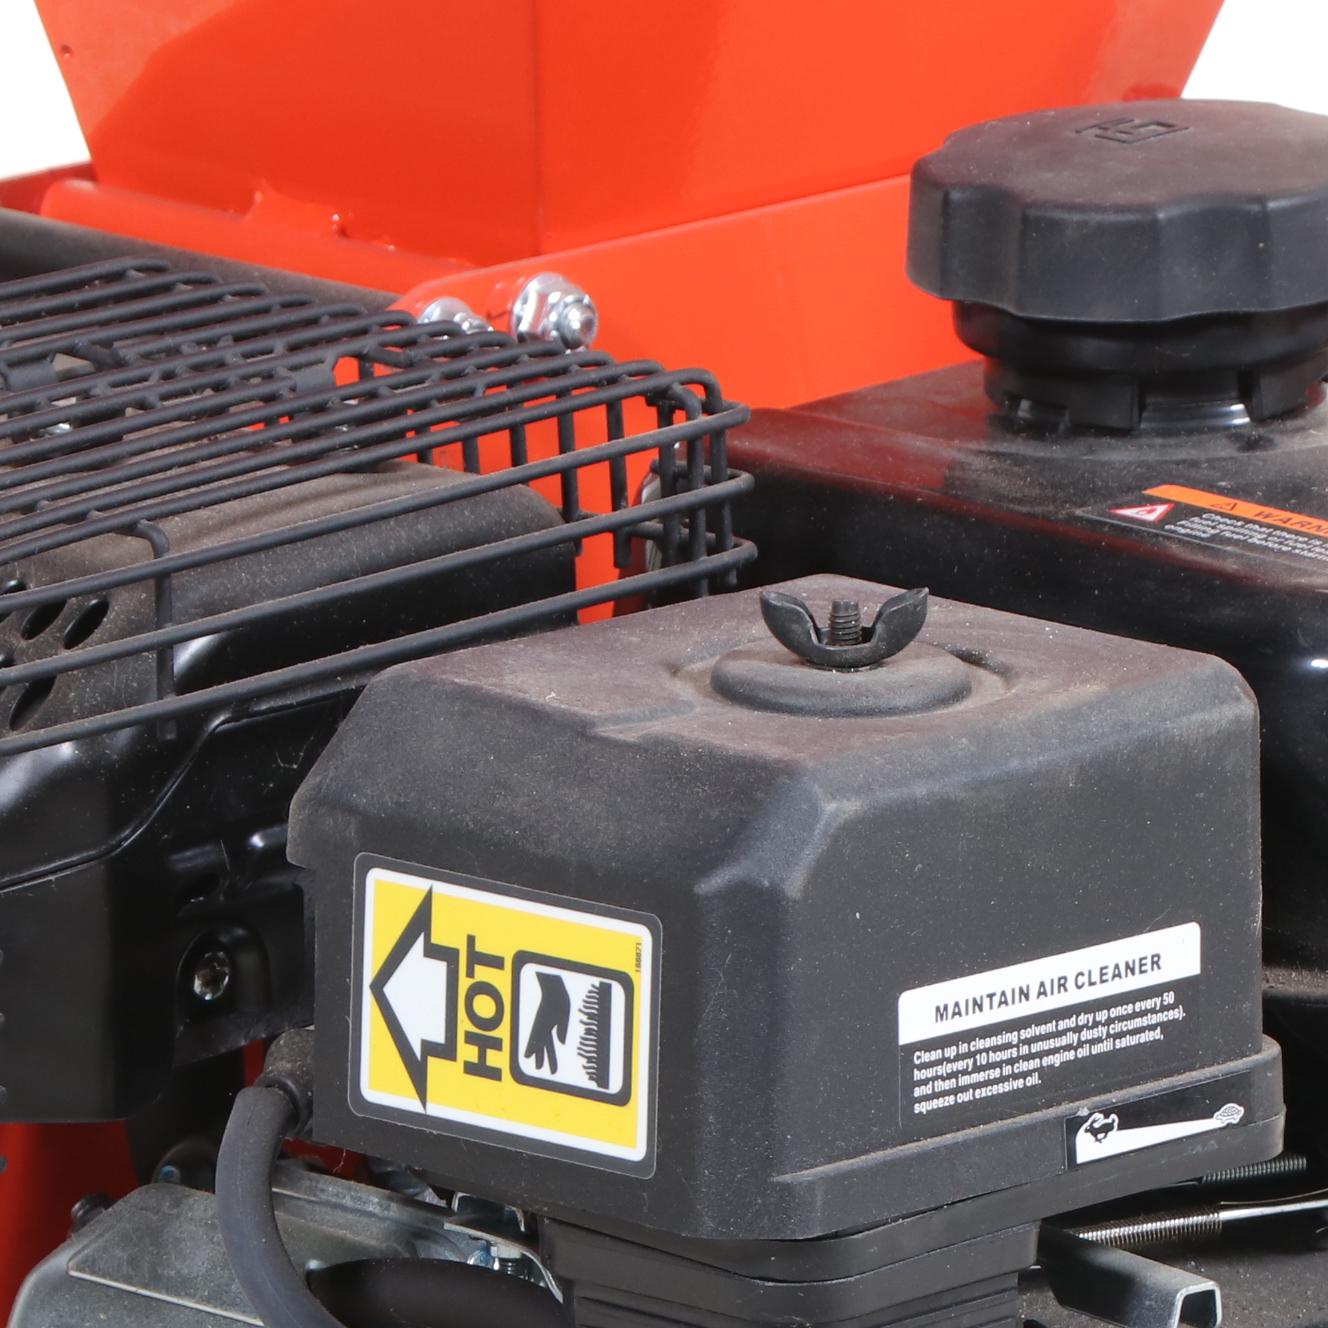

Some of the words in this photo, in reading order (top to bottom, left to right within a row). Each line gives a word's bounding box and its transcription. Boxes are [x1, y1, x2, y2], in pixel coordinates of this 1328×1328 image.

[463, 933, 505, 1082] HOT
[934, 983, 1030, 1024] MAINTAIN
[1036, 975, 1069, 1000] AIR
[1074, 953, 1162, 990] CLEANER
[913, 1048, 942, 1065] Clean
[944, 1045, 957, 1060] up
[958, 1041, 969, 1055] in
[970, 1031, 1018, 1052] cleansing
[1019, 1020, 1056, 1040] solvent
[1057, 1014, 1076, 1031] and
[1078, 1012, 1094, 1027] dry
[1095, 1009, 1108, 1023] up
[1110, 1003, 1133, 1018] once
[1134, 996, 1162, 1012] every
[1163, 990, 1175, 1006] 50
[913, 1081, 933, 1098] and
[934, 1077, 957, 1093] then
[958, 1067, 1001, 1087] immerse
[1002, 1063, 1012, 1077] in
[1013, 1056, 1041, 1074] clean
[1041, 1049, 1075, 1067] engine
[1076, 1043, 1090, 1059] oil
[1091, 1038, 1114, 1055] until
[1115, 1026, 1164, 1050] saturated,
[975, 1052, 988, 1066] 10
[988, 1046, 1018, 1063] hours
[1019, 1043, 1029, 1056] in
[1030, 1031, 1079, 1054] unusually
[1080, 1024, 1108, 1042] dusty
[1109, 1004, 1186, 1034] circumstances).
[913, 1094, 955, 1115] squeeze
[956, 1089, 974, 1104] out
[974, 1077, 1025, 1099] excessive
[1025, 1072, 1042, 1087] oil.
